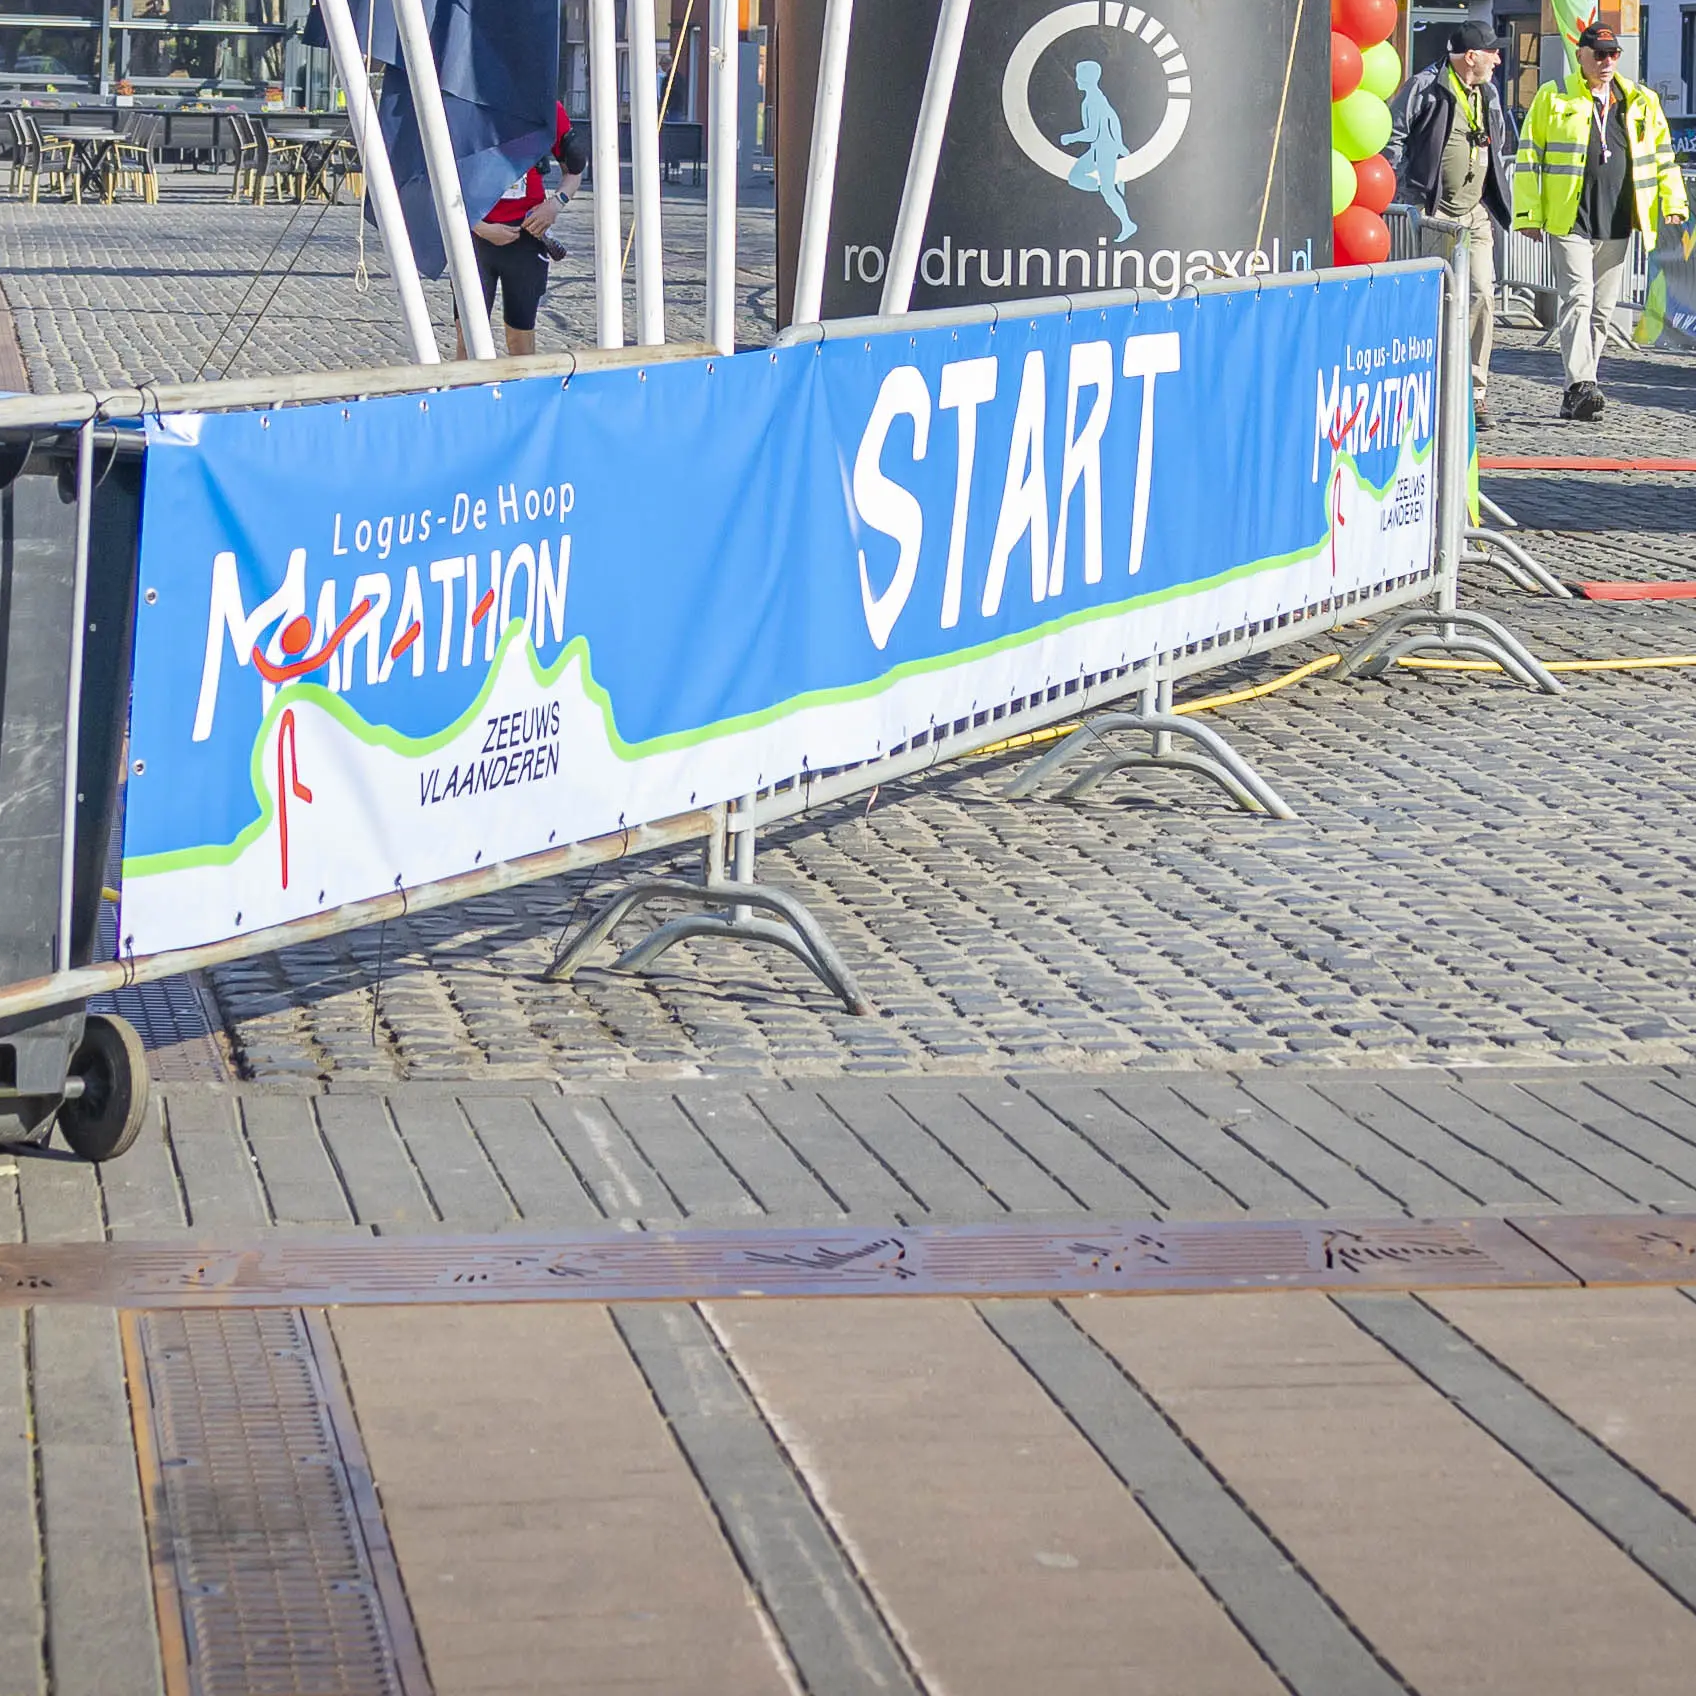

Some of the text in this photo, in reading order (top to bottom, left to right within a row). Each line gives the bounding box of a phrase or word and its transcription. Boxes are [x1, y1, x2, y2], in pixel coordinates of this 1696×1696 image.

[844, 235, 1314, 301] rodrunningaxelnl
[1346, 335, 1434, 376] Logus-De Hoop
[1311, 364, 1432, 484] MARATHON
[332, 481, 576, 561] Logus-De Hoop
[852, 331, 1182, 651] START
[191, 534, 573, 743] MARATHON
[480, 700, 561, 755] ZEEUWS
[418, 741, 560, 808] VLAANDEREN
